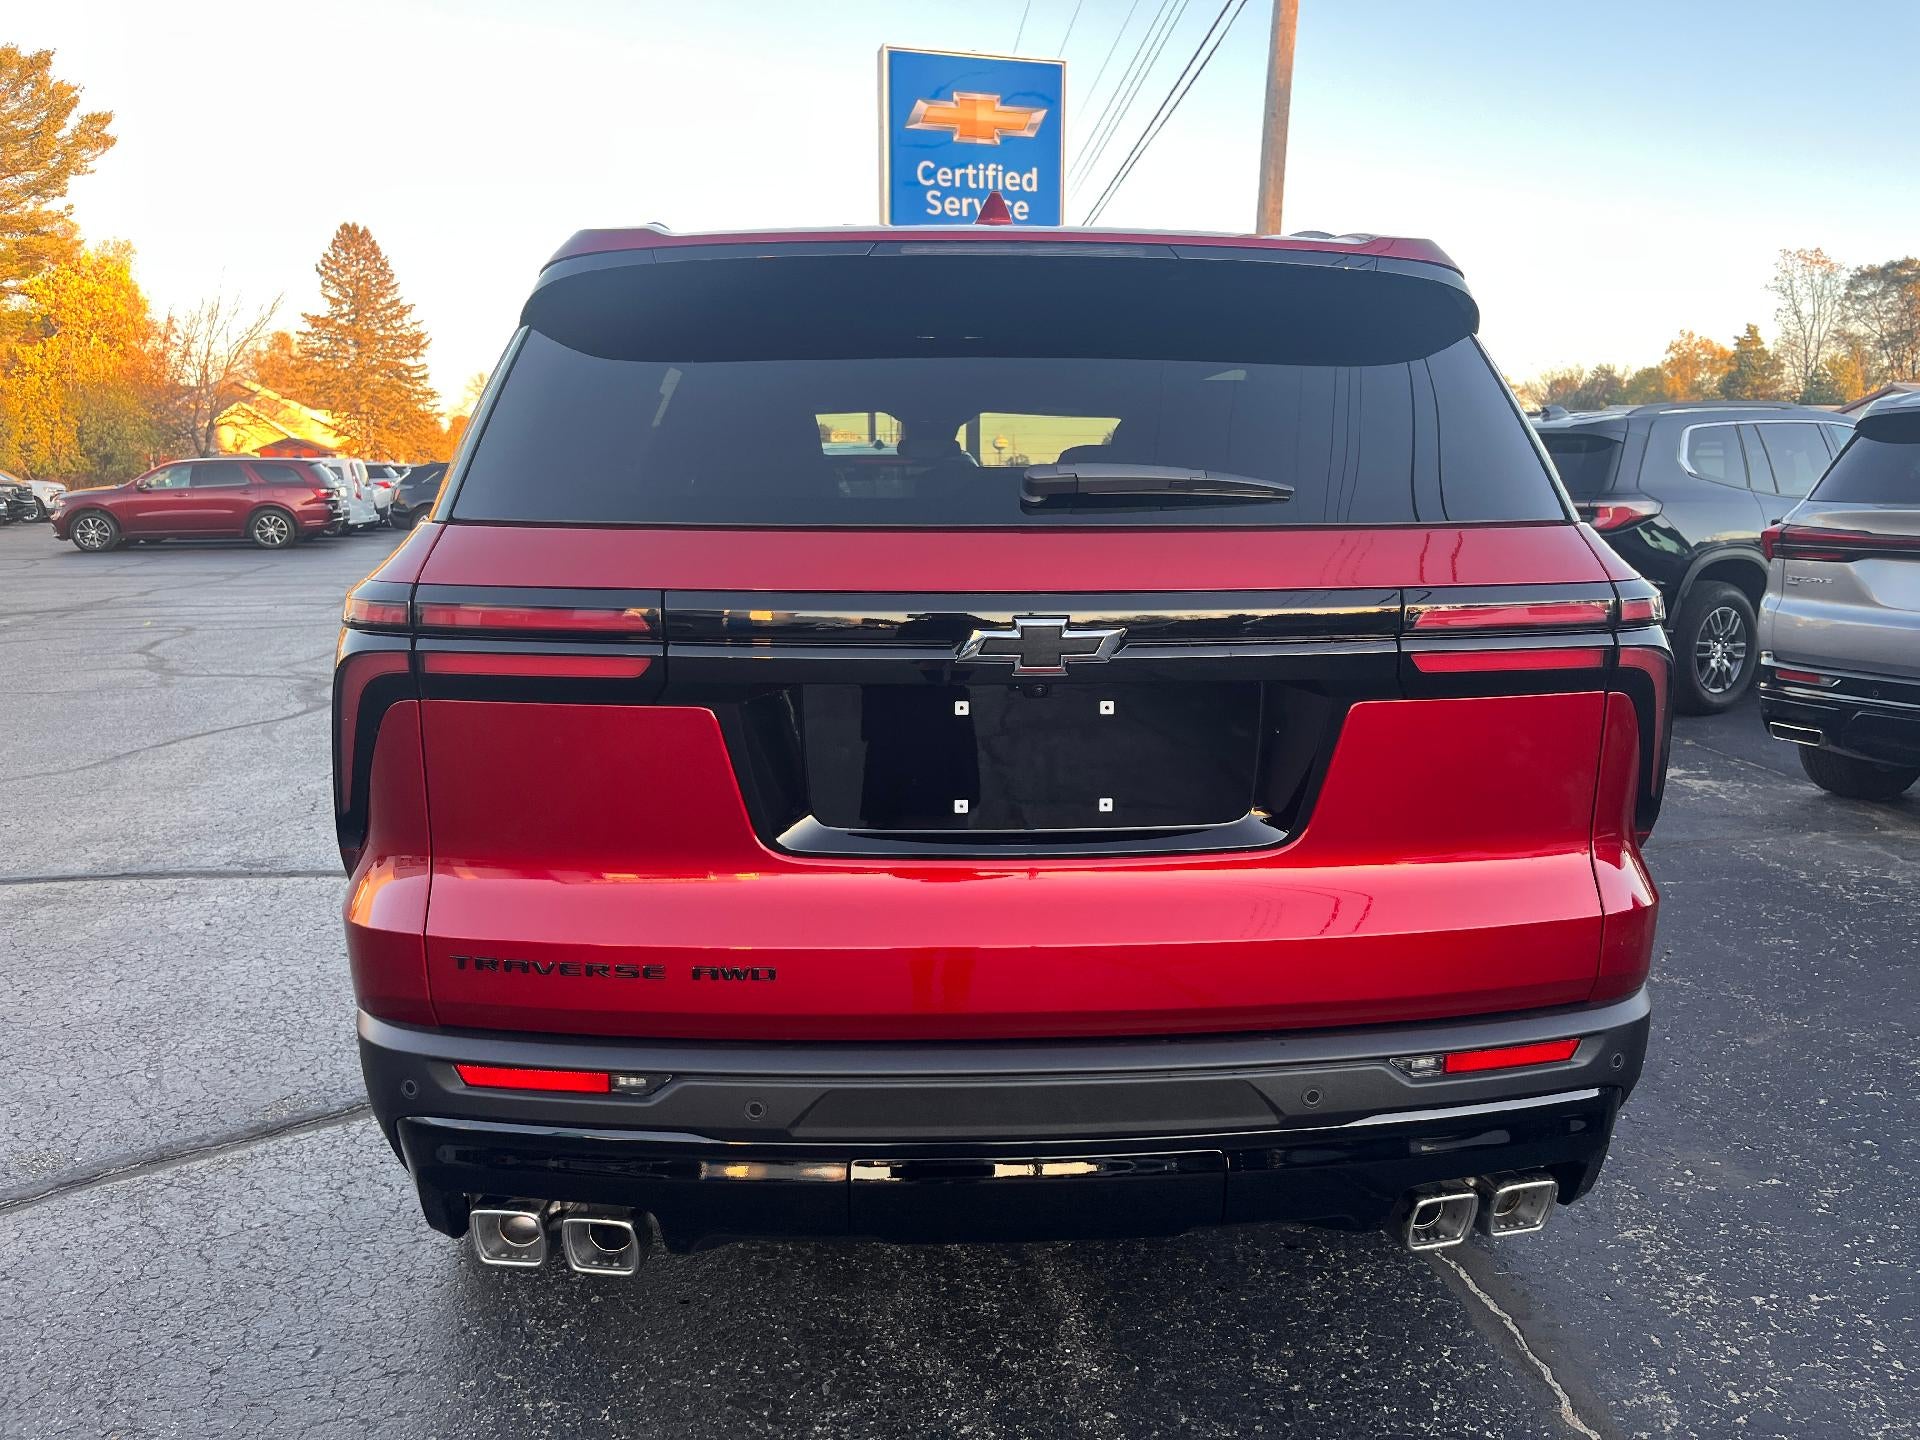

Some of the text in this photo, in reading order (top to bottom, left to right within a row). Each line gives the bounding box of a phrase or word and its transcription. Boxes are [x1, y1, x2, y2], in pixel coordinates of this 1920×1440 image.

[916, 160, 1038, 192] Certified
[926, 190, 1030, 220] Serve
[449, 954, 777, 981] TRAVERSE AWD
